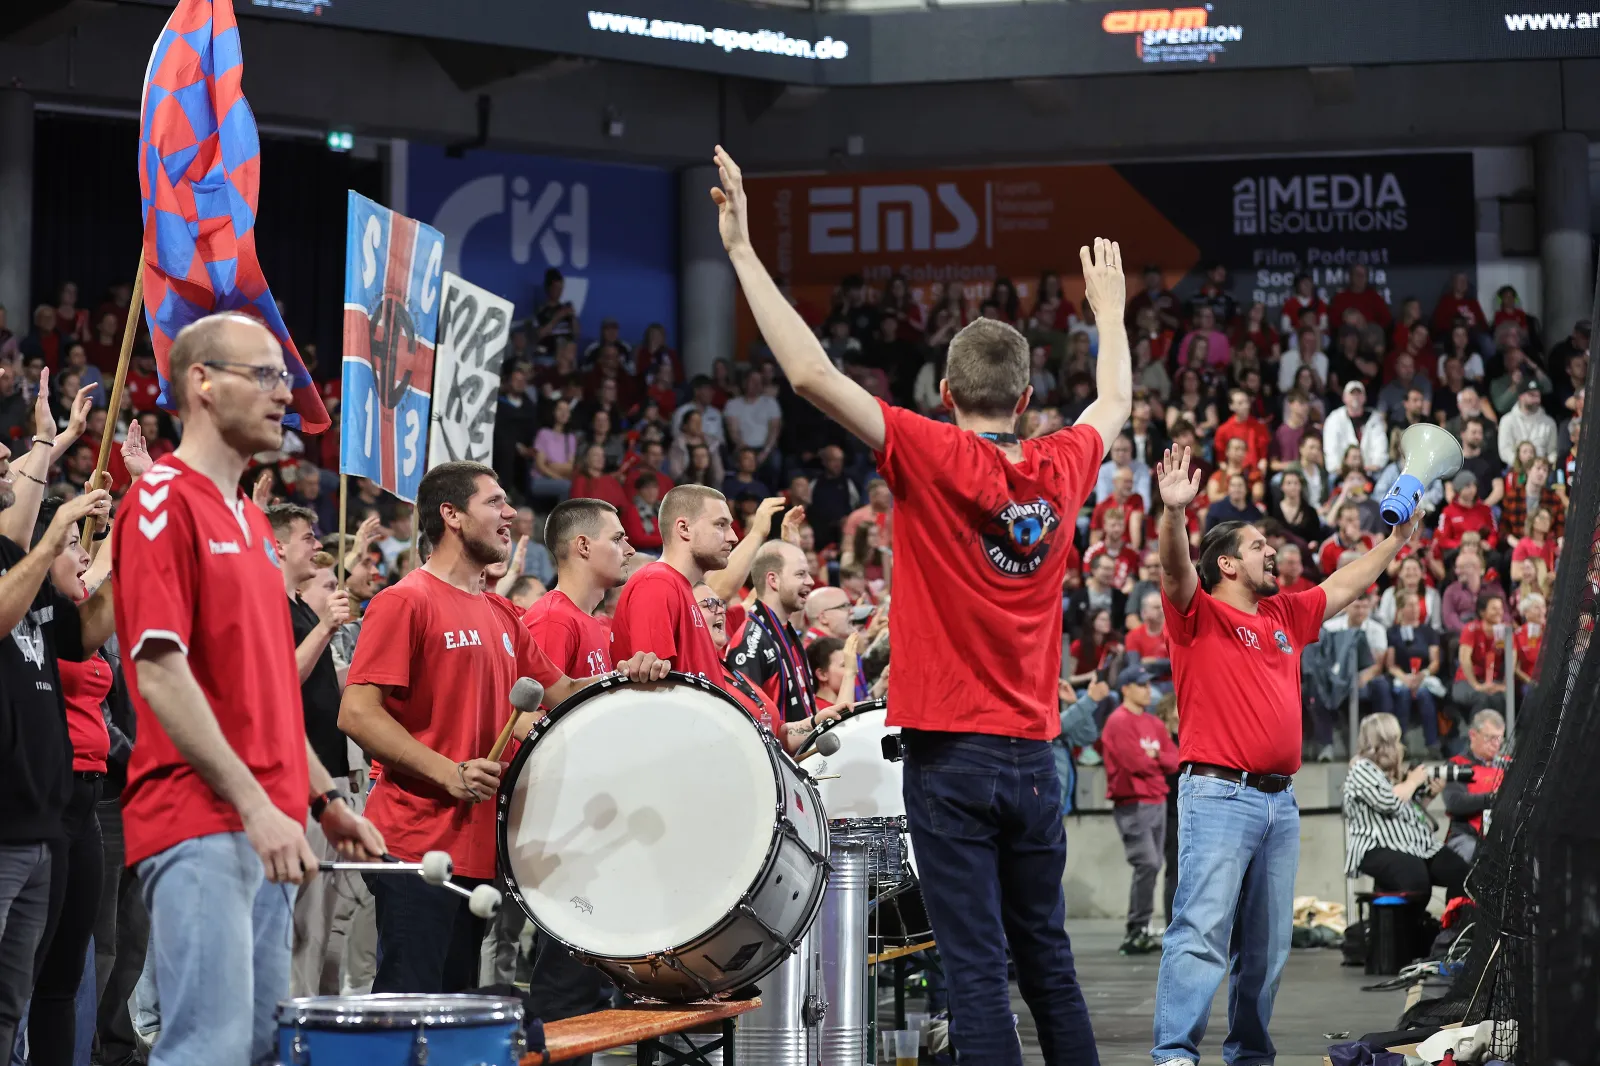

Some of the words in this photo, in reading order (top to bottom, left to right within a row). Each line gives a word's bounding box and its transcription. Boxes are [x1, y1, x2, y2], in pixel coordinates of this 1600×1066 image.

[588, 10, 848, 59] www.amm-spedition.de
[1142, 25, 1243, 45] SPEDITION
[1268, 173, 1407, 210] MEDIA
[808, 182, 979, 254] EMS
[1269, 210, 1408, 234] SOLUTIONS
[1307, 247, 1389, 265] Podcast
[903, 264, 997, 281] Solutions
[1257, 268, 1319, 287] Socl
[988, 545, 1042, 572] ERLANGEN
[444, 630, 482, 649] E.A.M
